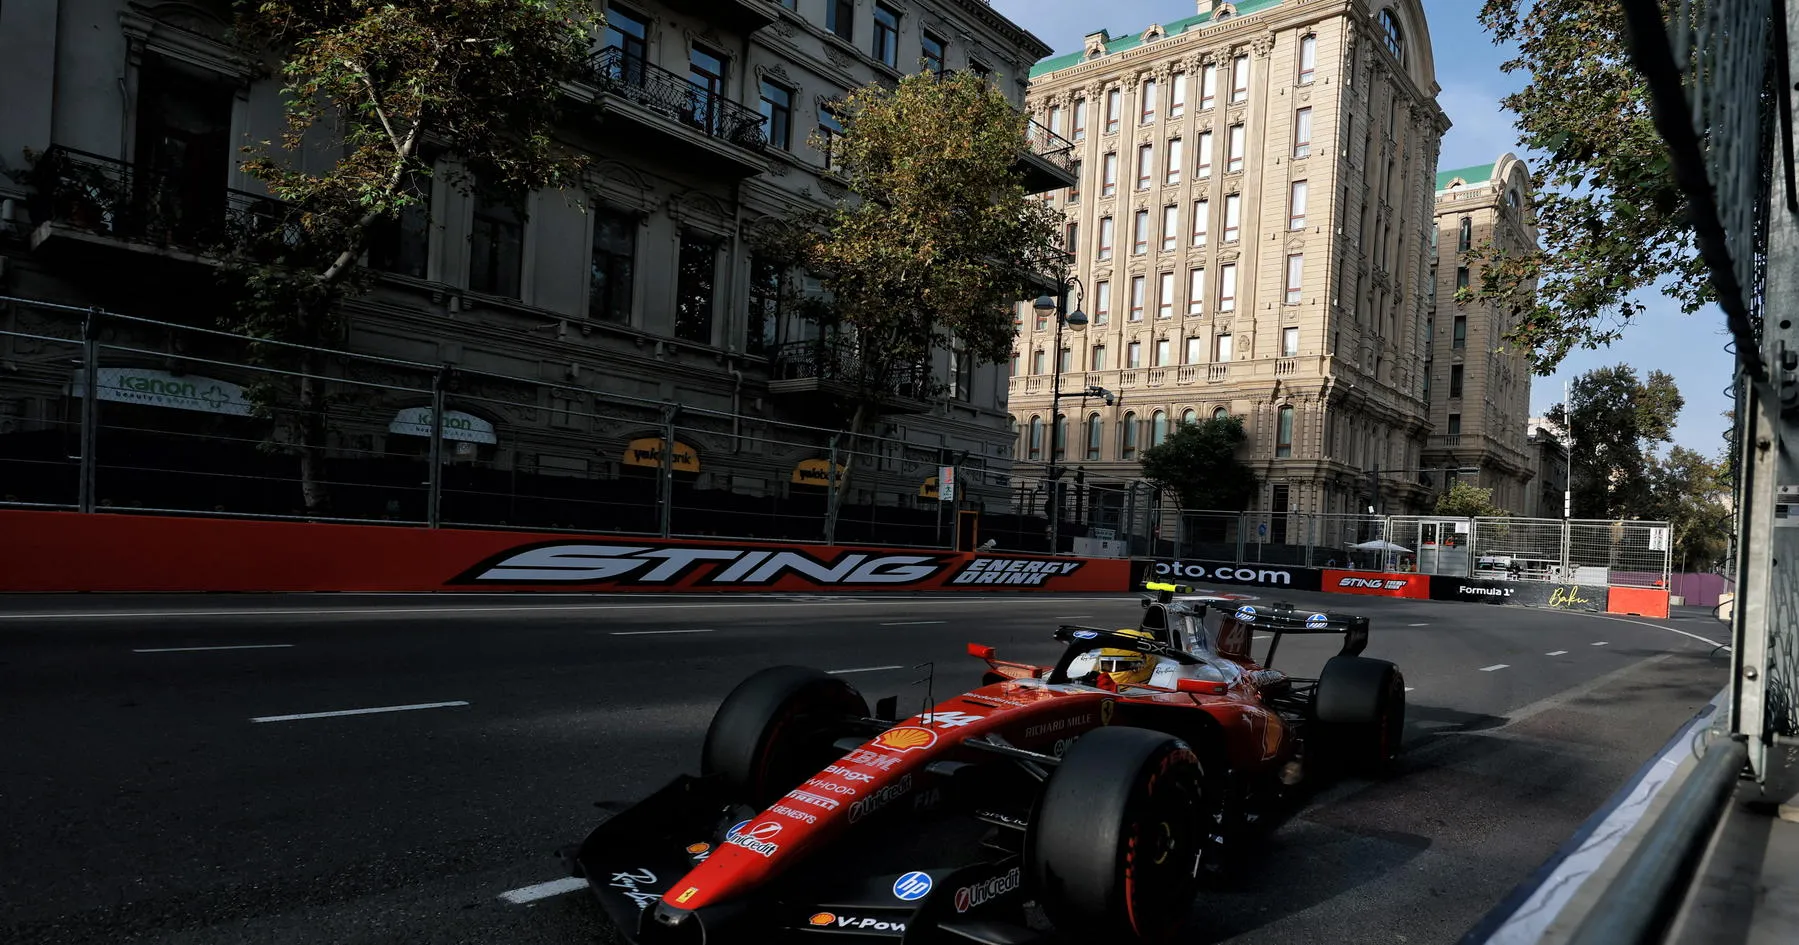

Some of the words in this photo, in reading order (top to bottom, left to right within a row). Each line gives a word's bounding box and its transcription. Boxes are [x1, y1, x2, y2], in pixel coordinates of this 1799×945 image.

[475, 544, 940, 584] STING
[965, 558, 1083, 575] ENERGY
[952, 571, 1049, 585] DRINK
[1339, 577, 1383, 588] STING
[1459, 585, 1502, 597] Formula
[1549, 586, 1589, 607] Baku
[915, 711, 985, 729] 44
[1025, 719, 1065, 738] RICHARD
[1066, 714, 1093, 728] MILLE
[841, 748, 902, 771] IBM
[805, 777, 856, 796] WHOOP
[861, 773, 912, 816] UniCredit
[913, 787, 940, 810] FIA
[772, 805, 817, 824] GENESYS
[896, 872, 930, 900] hp
[968, 867, 1019, 906] UniCredit
